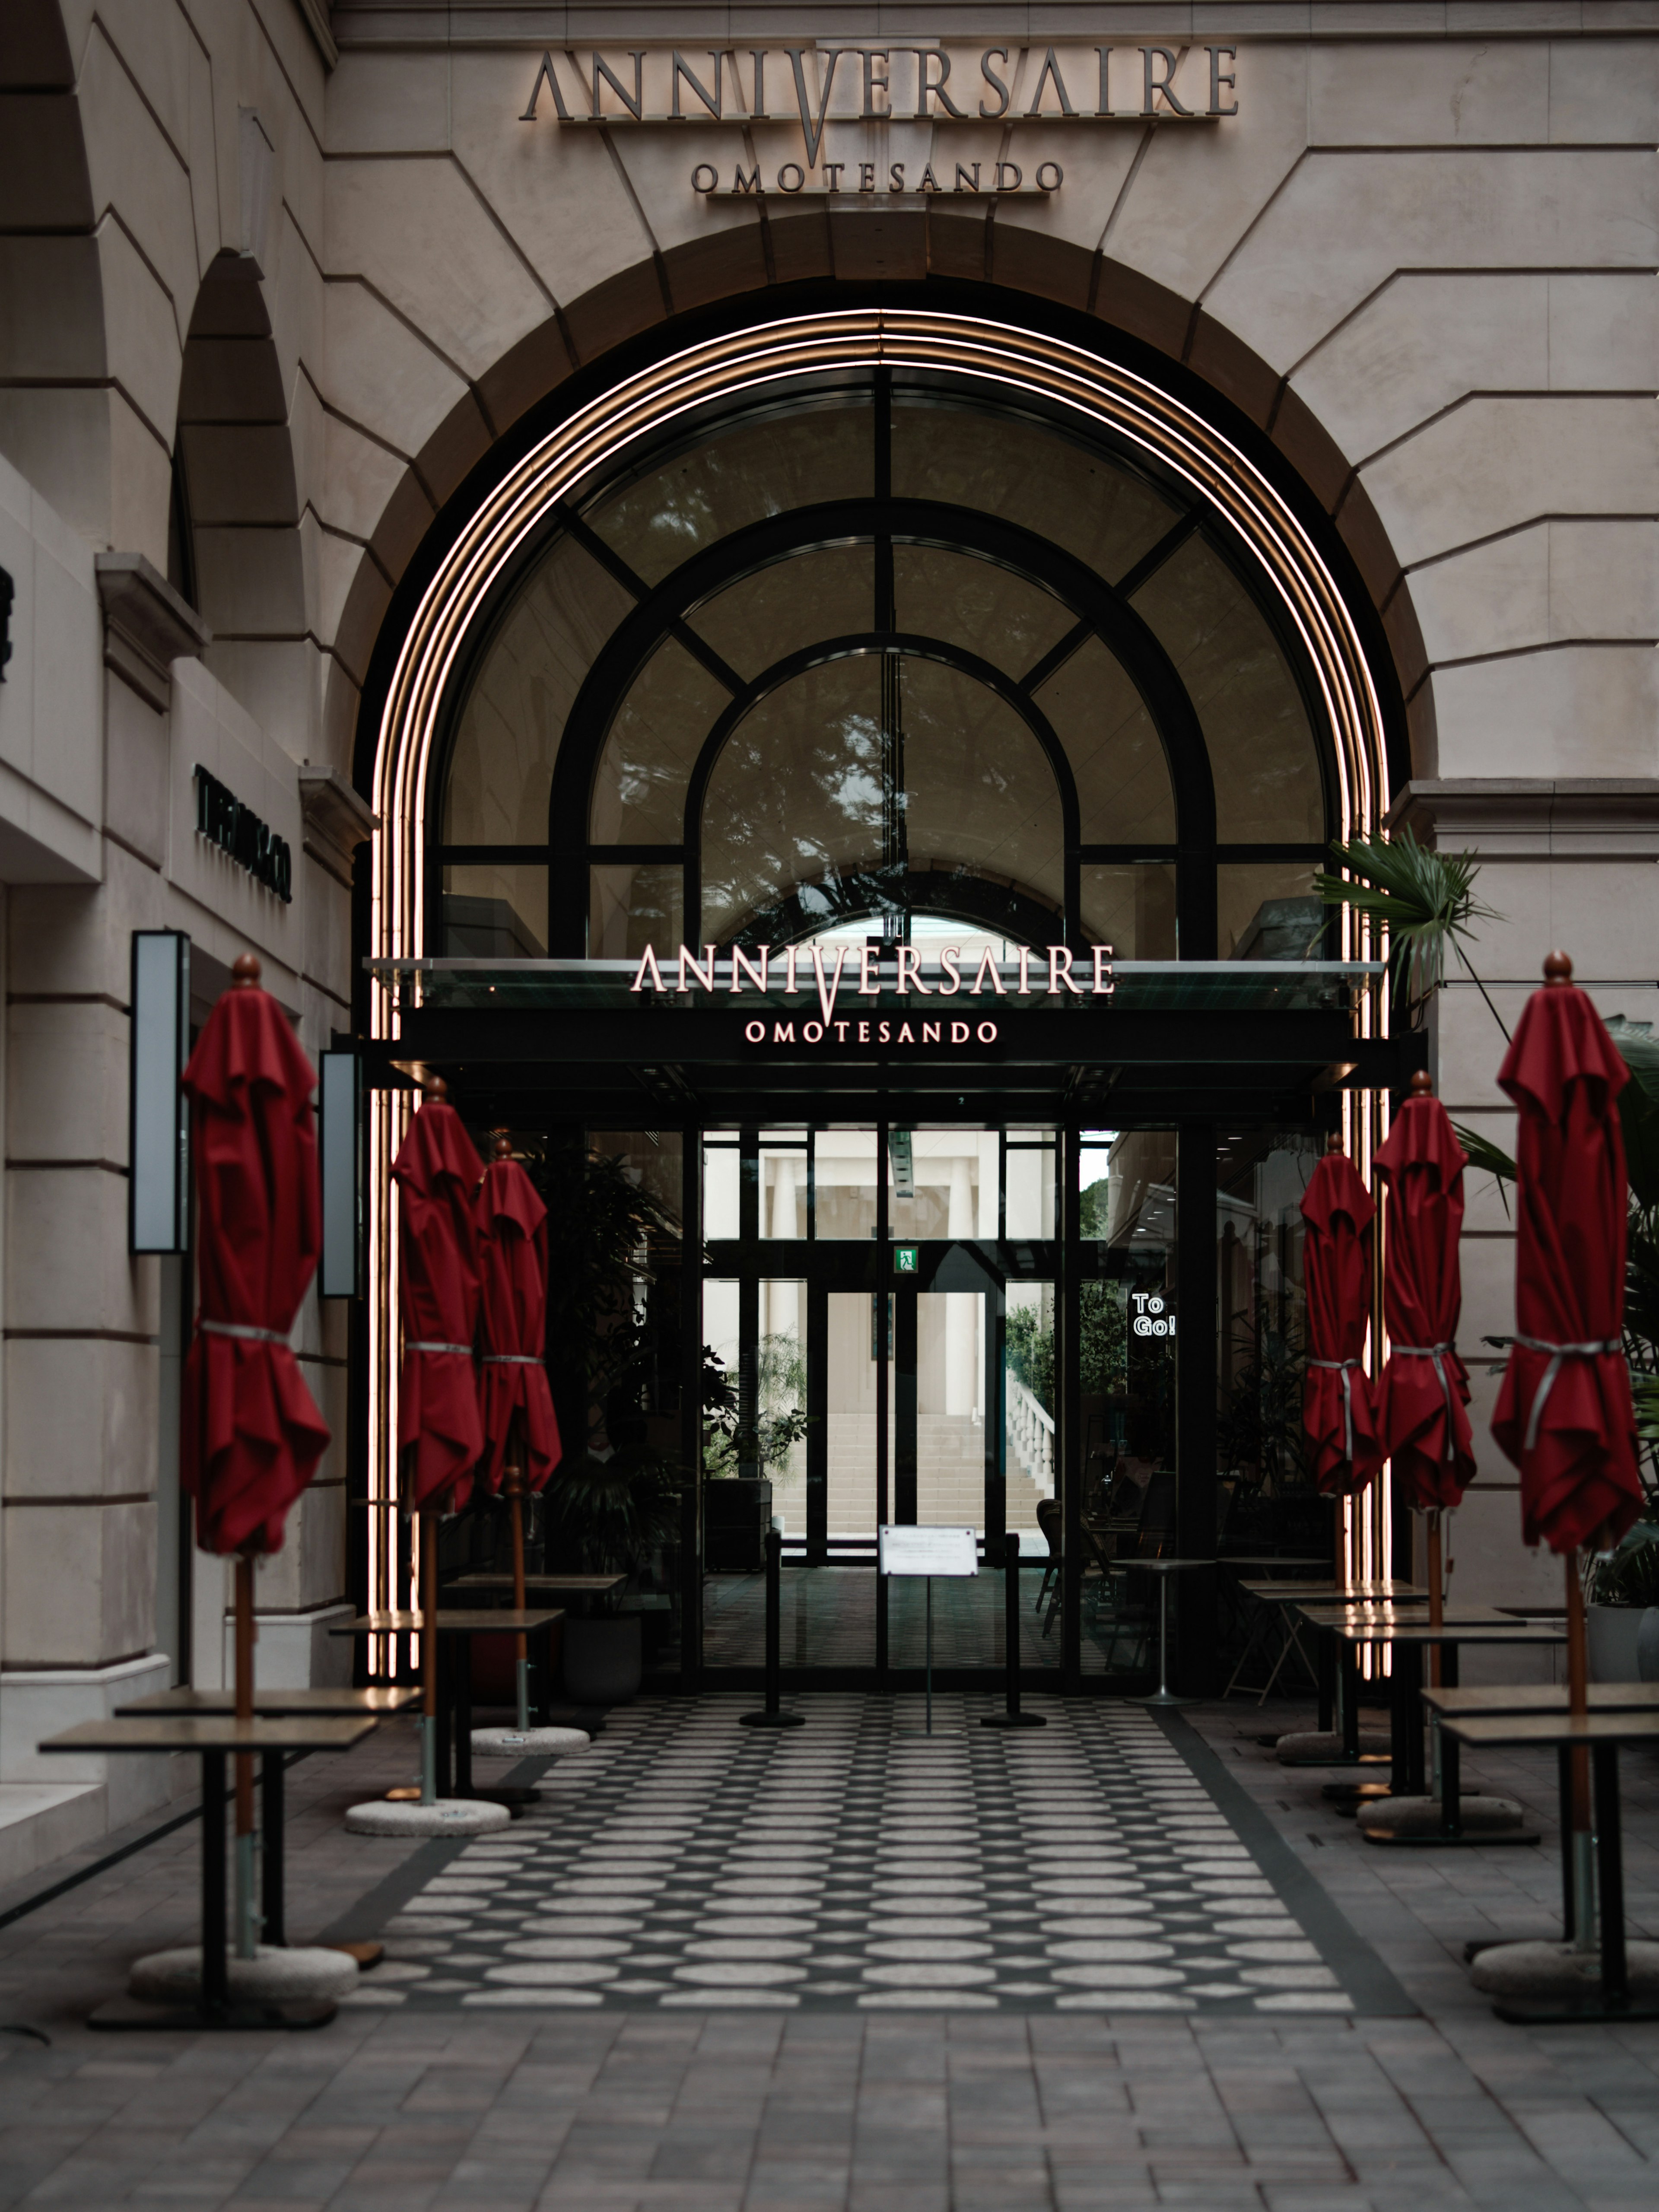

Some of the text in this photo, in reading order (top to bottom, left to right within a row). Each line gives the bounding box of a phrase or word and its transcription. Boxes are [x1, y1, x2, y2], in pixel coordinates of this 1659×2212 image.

[518, 45, 1239, 168] ANNIVERSAIRE
[691, 162, 1064, 194] OMOTESANDO
[630, 943, 1116, 1027] ANNIVERSAIRE
[745, 1020, 998, 1043] OMOTESANDO
[1132, 1293, 1163, 1313] To
[1133, 1315, 1176, 1336] Go!
